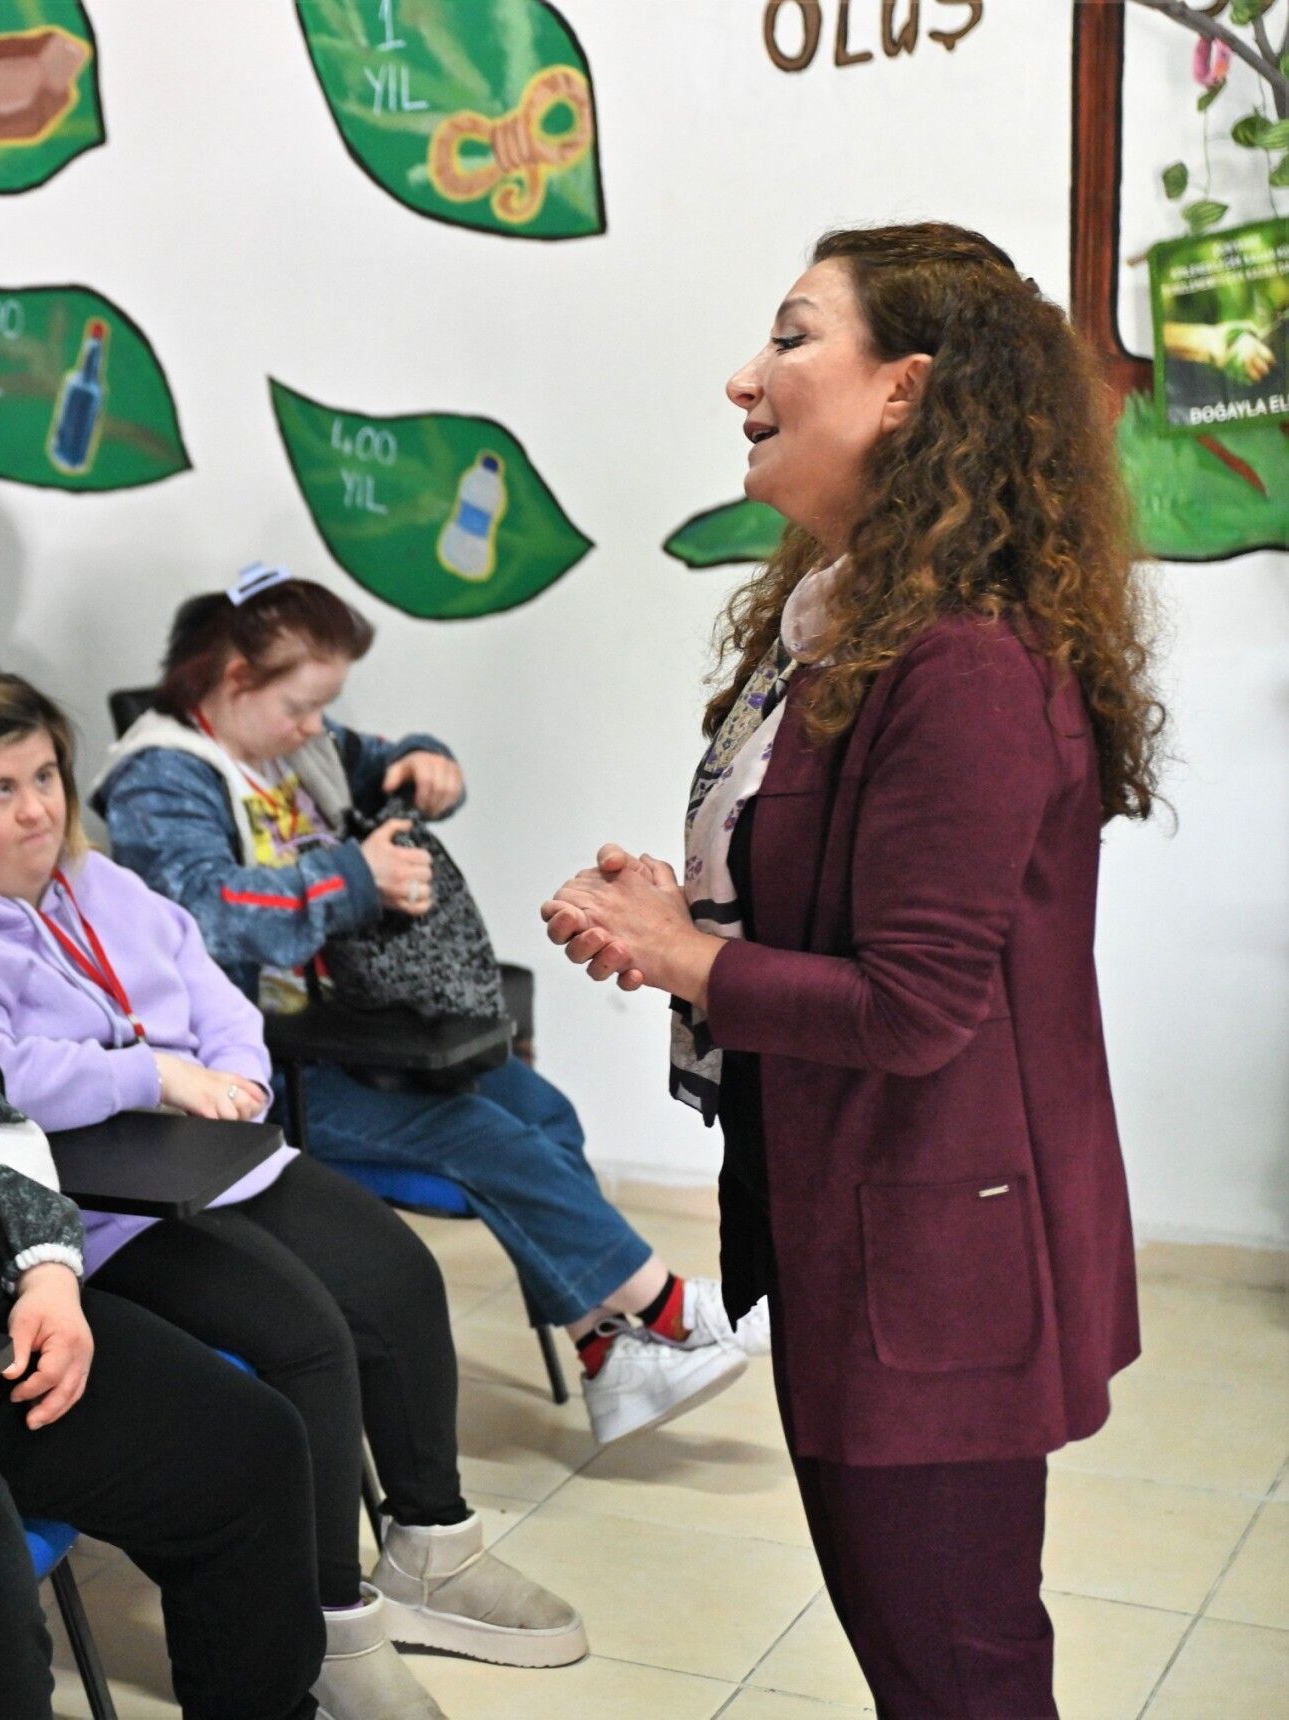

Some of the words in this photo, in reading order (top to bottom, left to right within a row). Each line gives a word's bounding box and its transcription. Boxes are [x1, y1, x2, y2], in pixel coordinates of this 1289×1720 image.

[363, 63, 430, 117] YIL
[1189, 398, 1267, 426] DOĞAYLA
[340, 467, 389, 514] YIL
